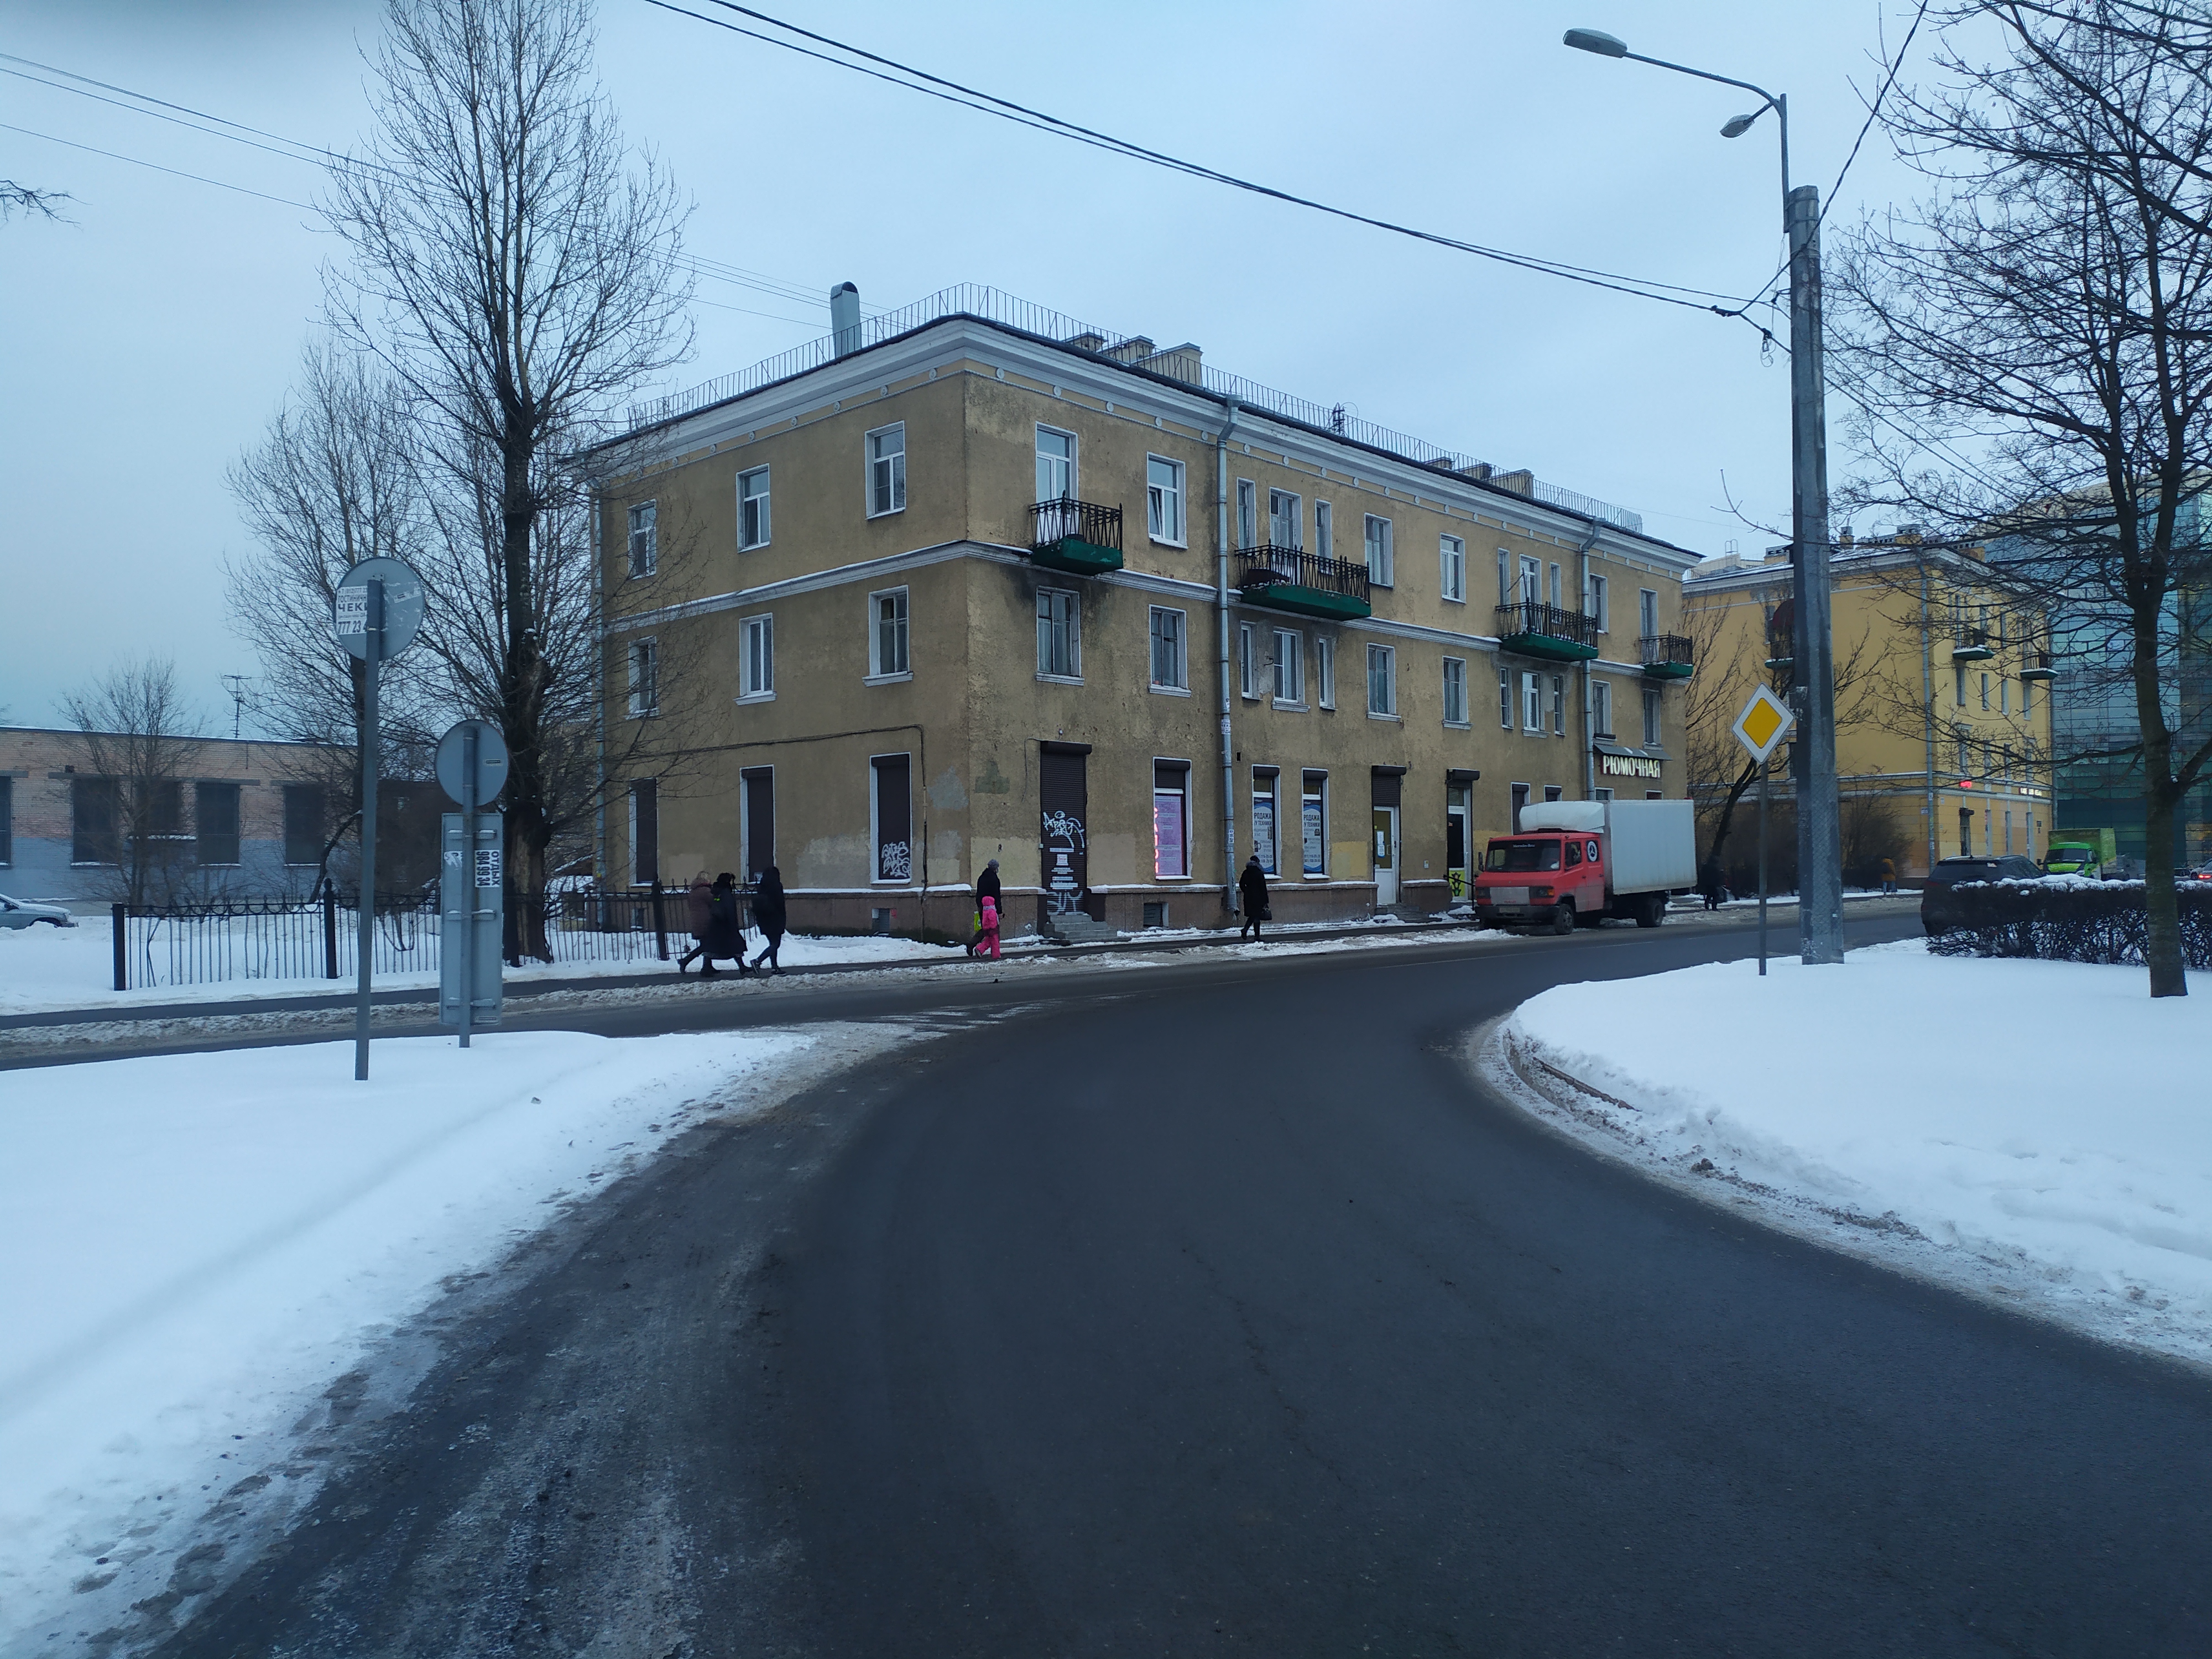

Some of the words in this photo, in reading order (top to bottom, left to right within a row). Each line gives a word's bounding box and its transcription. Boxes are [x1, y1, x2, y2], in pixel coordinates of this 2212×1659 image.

[338, 621, 351, 633] 777
[352, 620, 361, 633] 23
[1603, 755, 1660, 778] РЮМОЧНАЯ
[476, 851, 490, 865] 984
[476, 867, 490, 876] 99
[490, 851, 499, 885] ОТДЫХ
[477, 877, 491, 886] 34
